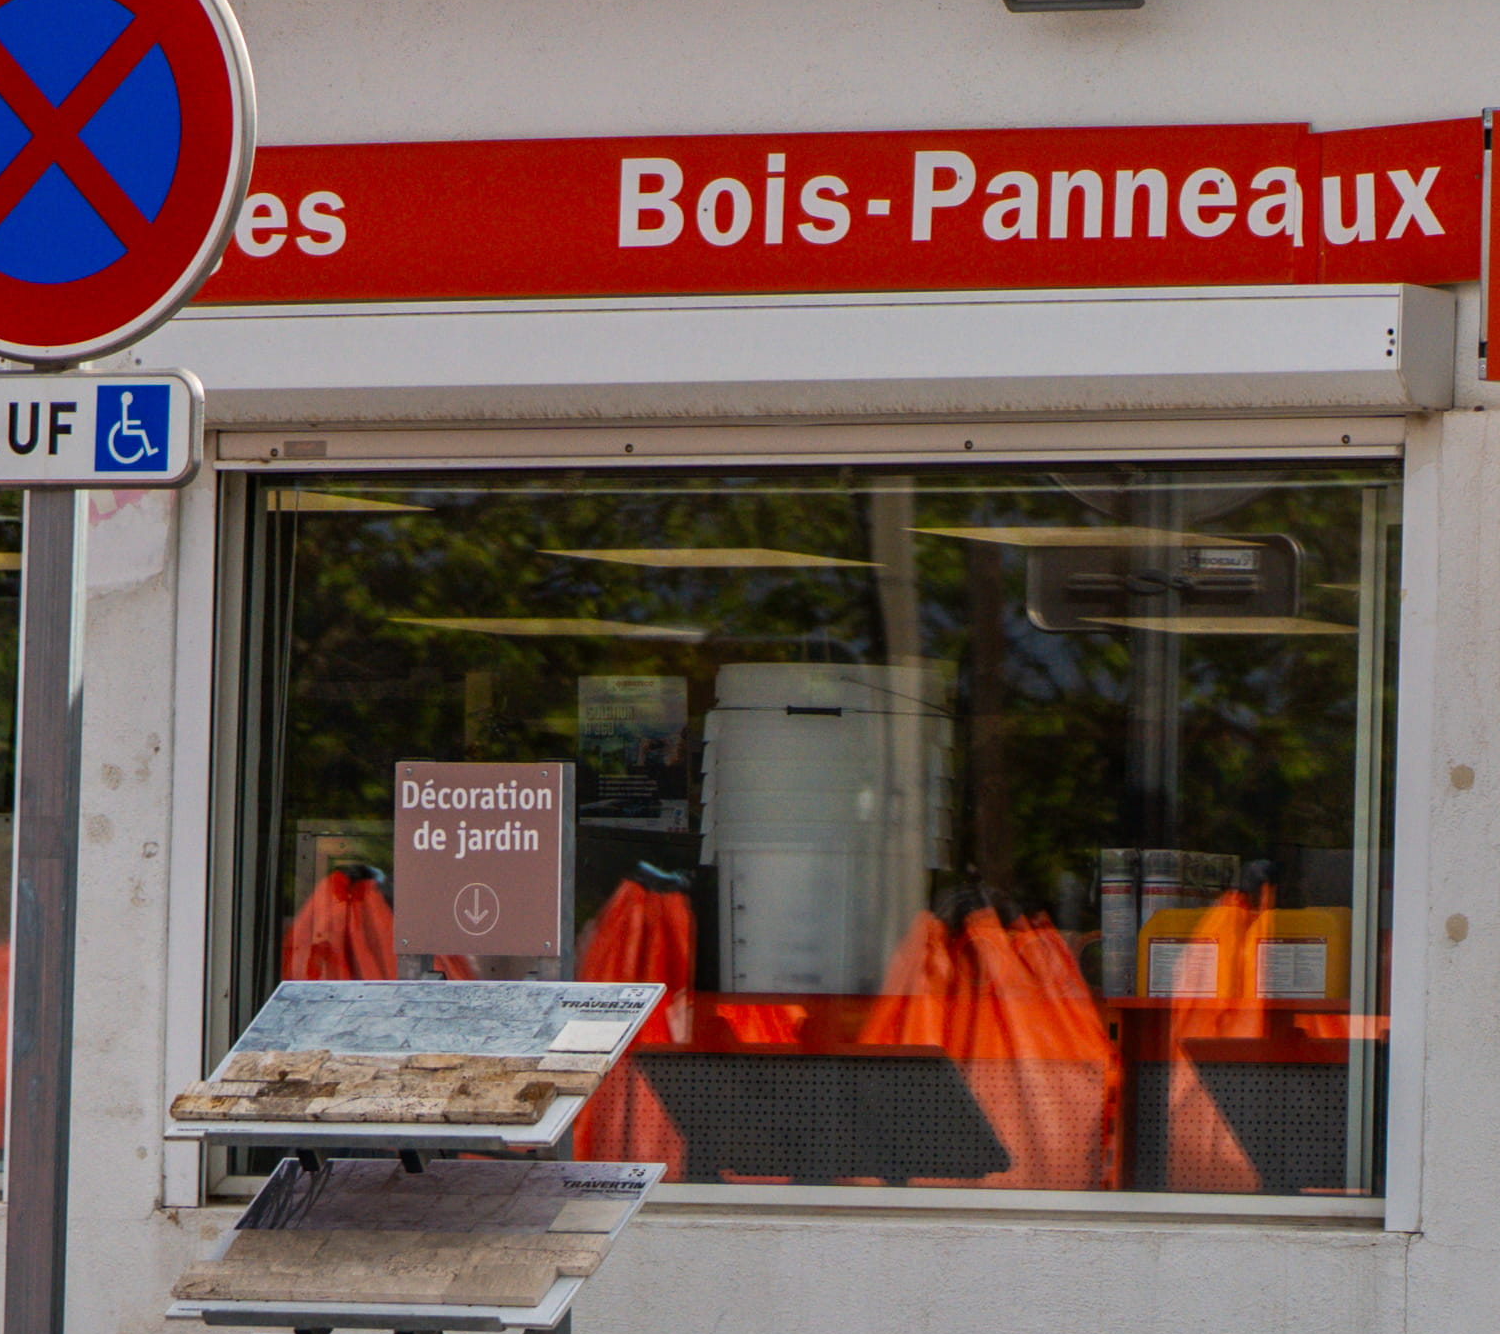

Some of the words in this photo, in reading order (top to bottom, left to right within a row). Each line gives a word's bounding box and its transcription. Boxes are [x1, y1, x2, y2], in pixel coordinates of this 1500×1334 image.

[617, 150, 1446, 249] Bois-Panneaux
[401, 779, 553, 810] Décoration
[413, 821, 447, 851] de
[455, 820, 540, 860] jardin
[561, 1000, 645, 1009] TRAVERTIN
[562, 1180, 647, 1189] TRAVERTIN
